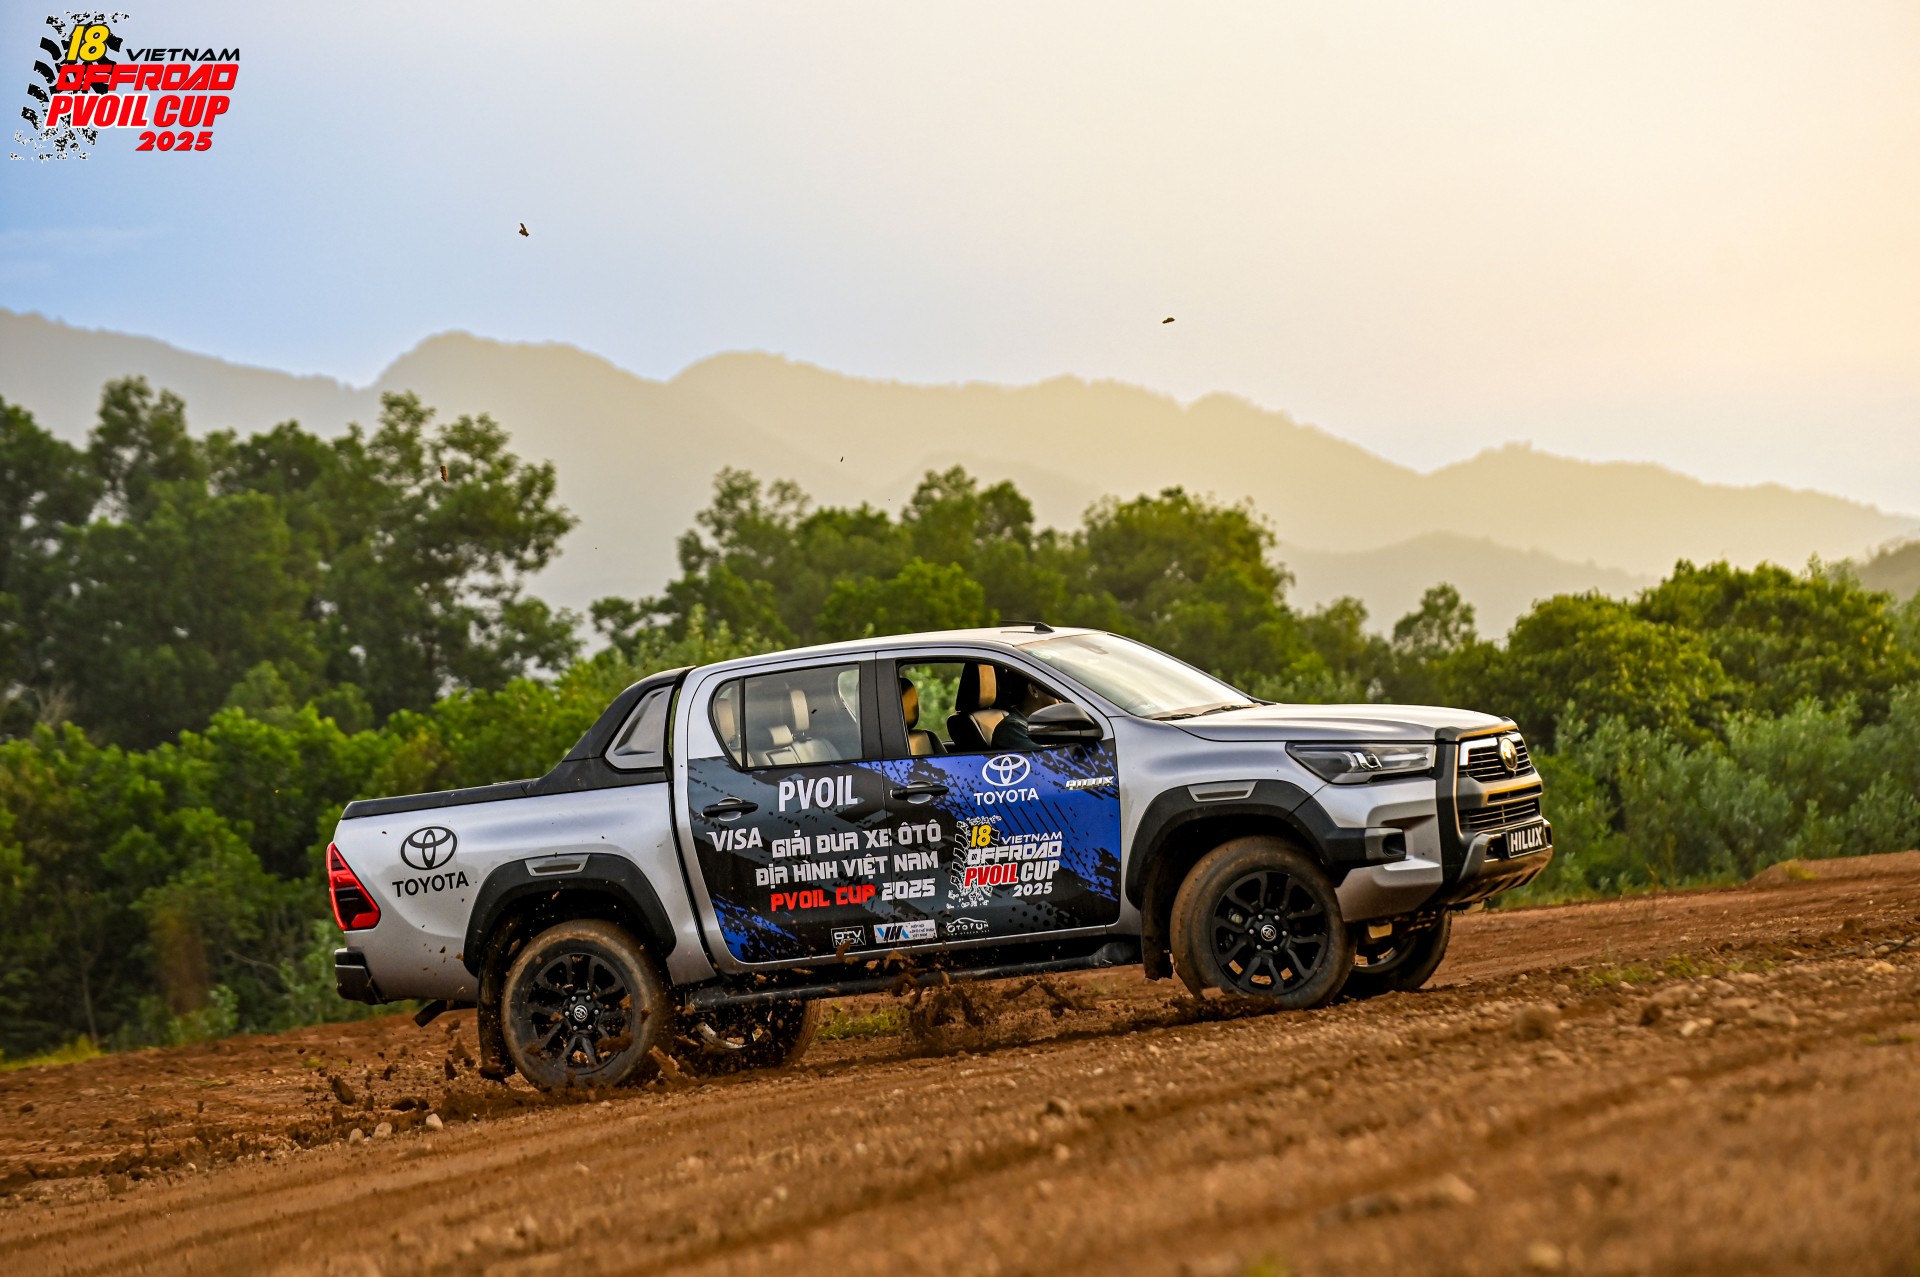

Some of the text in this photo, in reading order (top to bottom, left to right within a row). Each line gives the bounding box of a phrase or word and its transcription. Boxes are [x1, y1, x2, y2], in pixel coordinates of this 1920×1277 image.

[778, 775, 858, 812] PVOIL
[973, 787, 1039, 806] TOYOTA
[706, 827, 763, 852] VISA
[772, 830, 811, 858] GIẢI
[862, 828, 893, 849] XE
[897, 819, 942, 846] ÔTÔ
[970, 824, 992, 847] 18
[1002, 831, 1062, 846] VIETNAM
[1510, 826, 1543, 853] HILUX
[967, 841, 1062, 865] OFFROAD
[792, 859, 838, 883] HÌNH
[841, 853, 888, 880] VIỆT
[893, 851, 939, 873] NAM
[964, 859, 1060, 887] PVOIL CUP
[392, 871, 469, 898] TOYOTA
[770, 878, 936, 912] PVOIL CUP 2025
[1012, 882, 1053, 898] 2025
